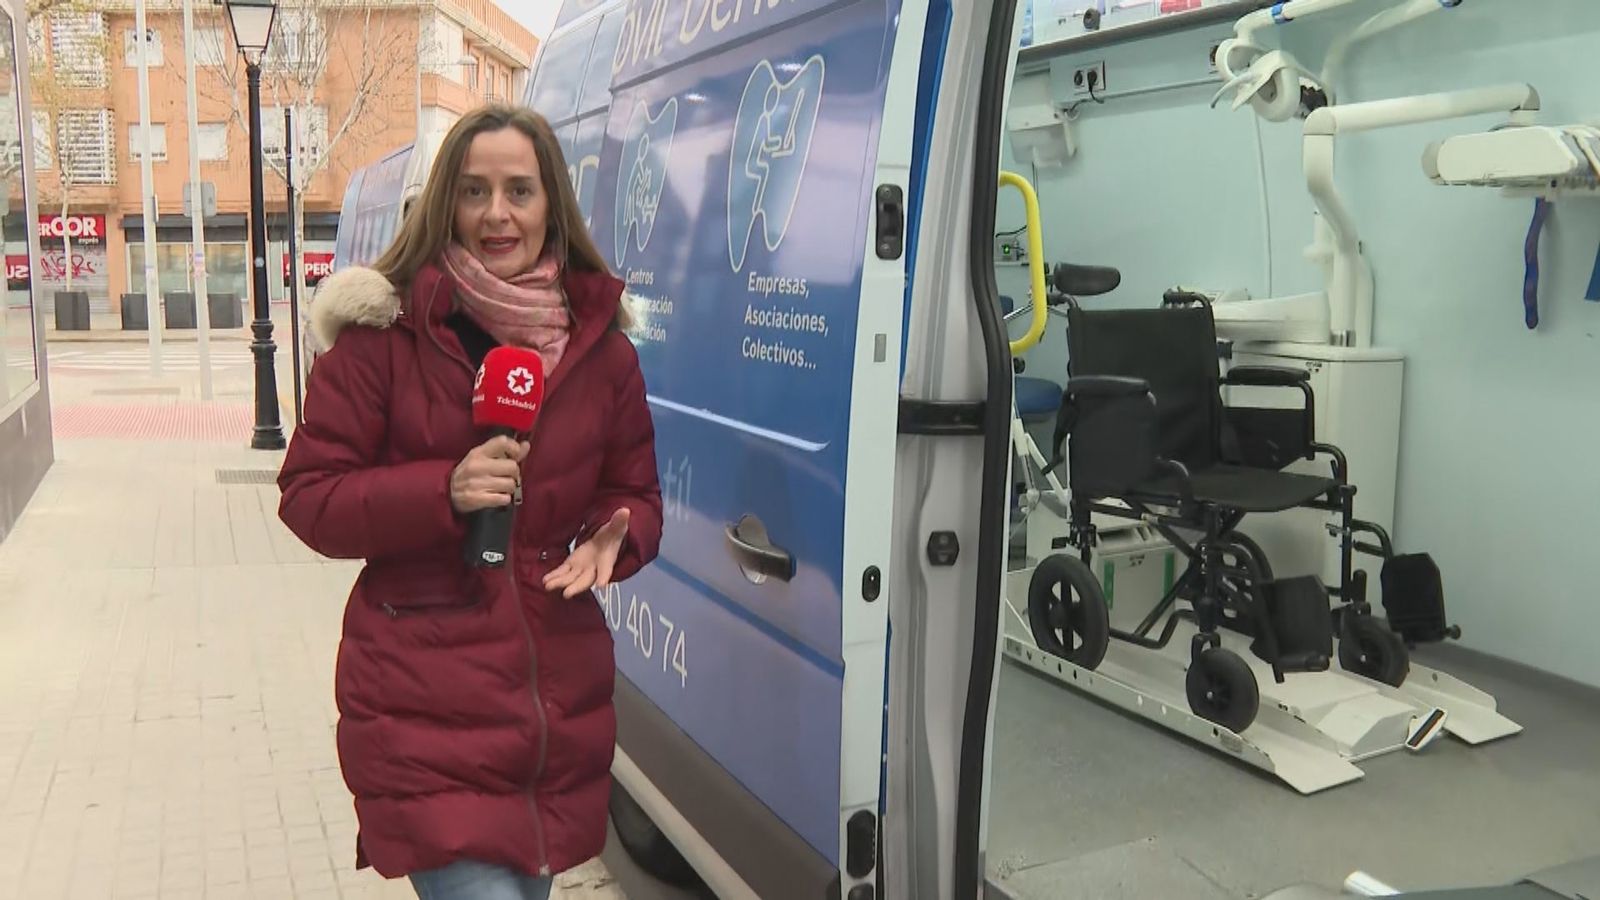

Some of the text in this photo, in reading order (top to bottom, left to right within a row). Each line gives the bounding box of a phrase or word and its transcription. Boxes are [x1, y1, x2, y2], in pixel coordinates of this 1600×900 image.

[626, 267, 654, 285] Centros
[748, 271, 810, 299] Empresas,
[744, 304, 829, 338] Asociaciones,
[742, 336, 817, 370] Colectivos...
[626, 593, 653, 659] 40
[659, 613, 689, 688] 74
